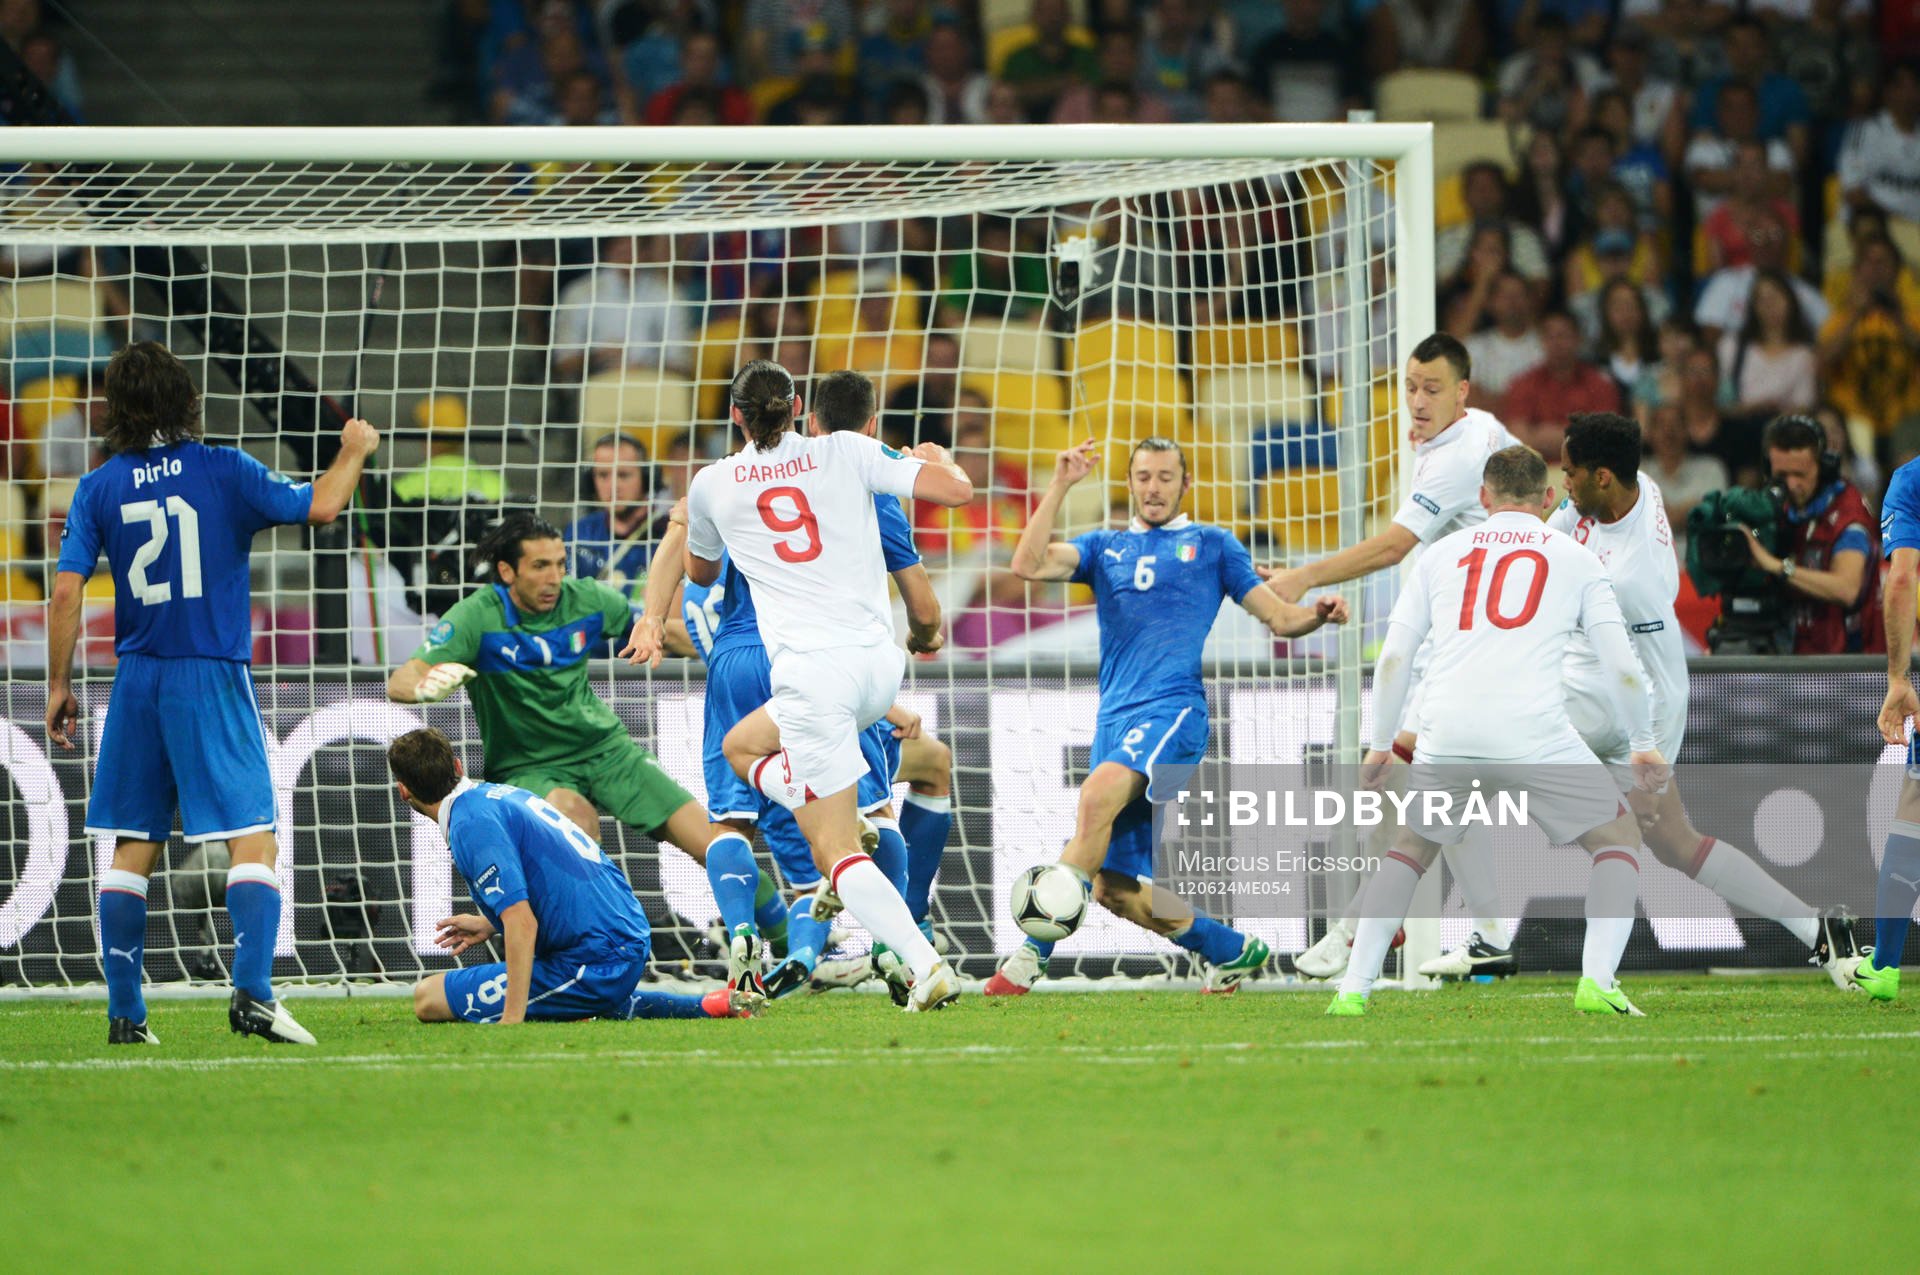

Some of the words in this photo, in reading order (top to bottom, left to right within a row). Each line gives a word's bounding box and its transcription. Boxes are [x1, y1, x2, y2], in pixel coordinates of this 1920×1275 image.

[734, 453, 818, 483] CARROLL
[756, 486, 823, 563] 9
[1472, 531, 1553, 545] ROONEY
[120, 495, 203, 606] 21
[1133, 555, 1157, 591] 6
[1457, 547, 1550, 630] 10
[533, 636, 552, 665] 1
[525, 795, 602, 864] 8
[477, 972, 508, 1005] 8
